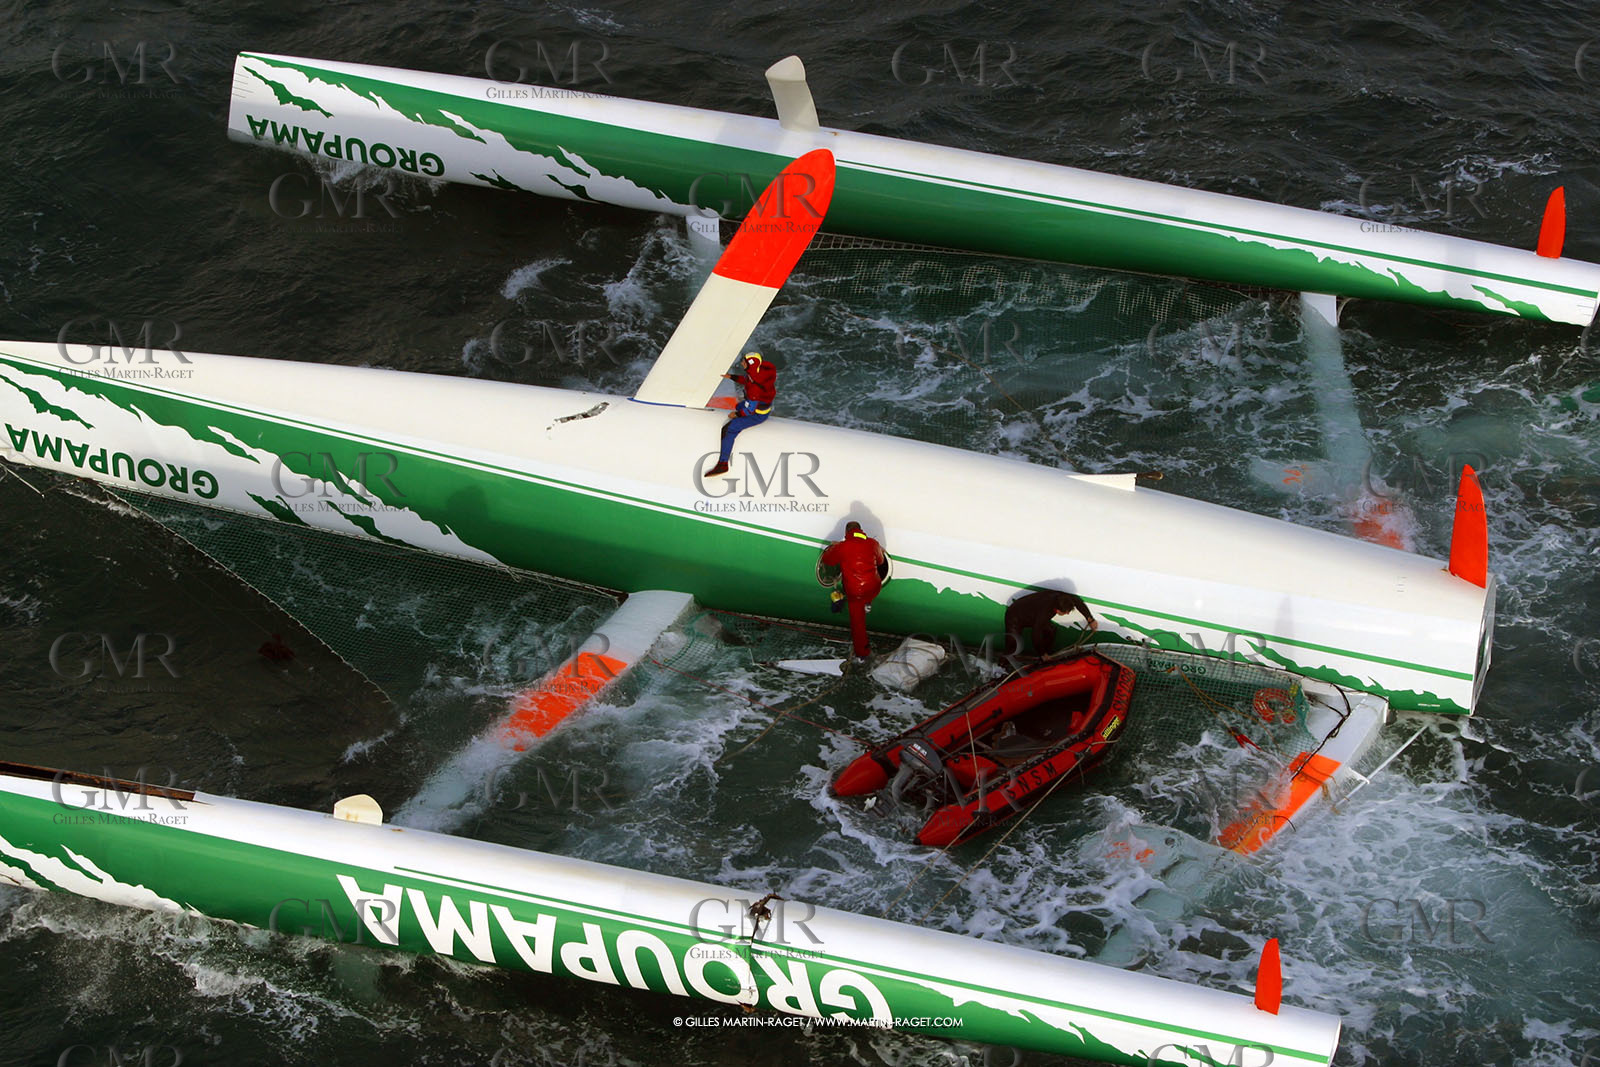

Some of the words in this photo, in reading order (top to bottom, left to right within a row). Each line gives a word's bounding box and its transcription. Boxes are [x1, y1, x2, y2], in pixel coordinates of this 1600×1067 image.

[246, 114, 445, 177] GROUPAMA
[4, 422, 219, 500] GROUPAMA
[336, 873, 894, 1029] GROUPAMA
